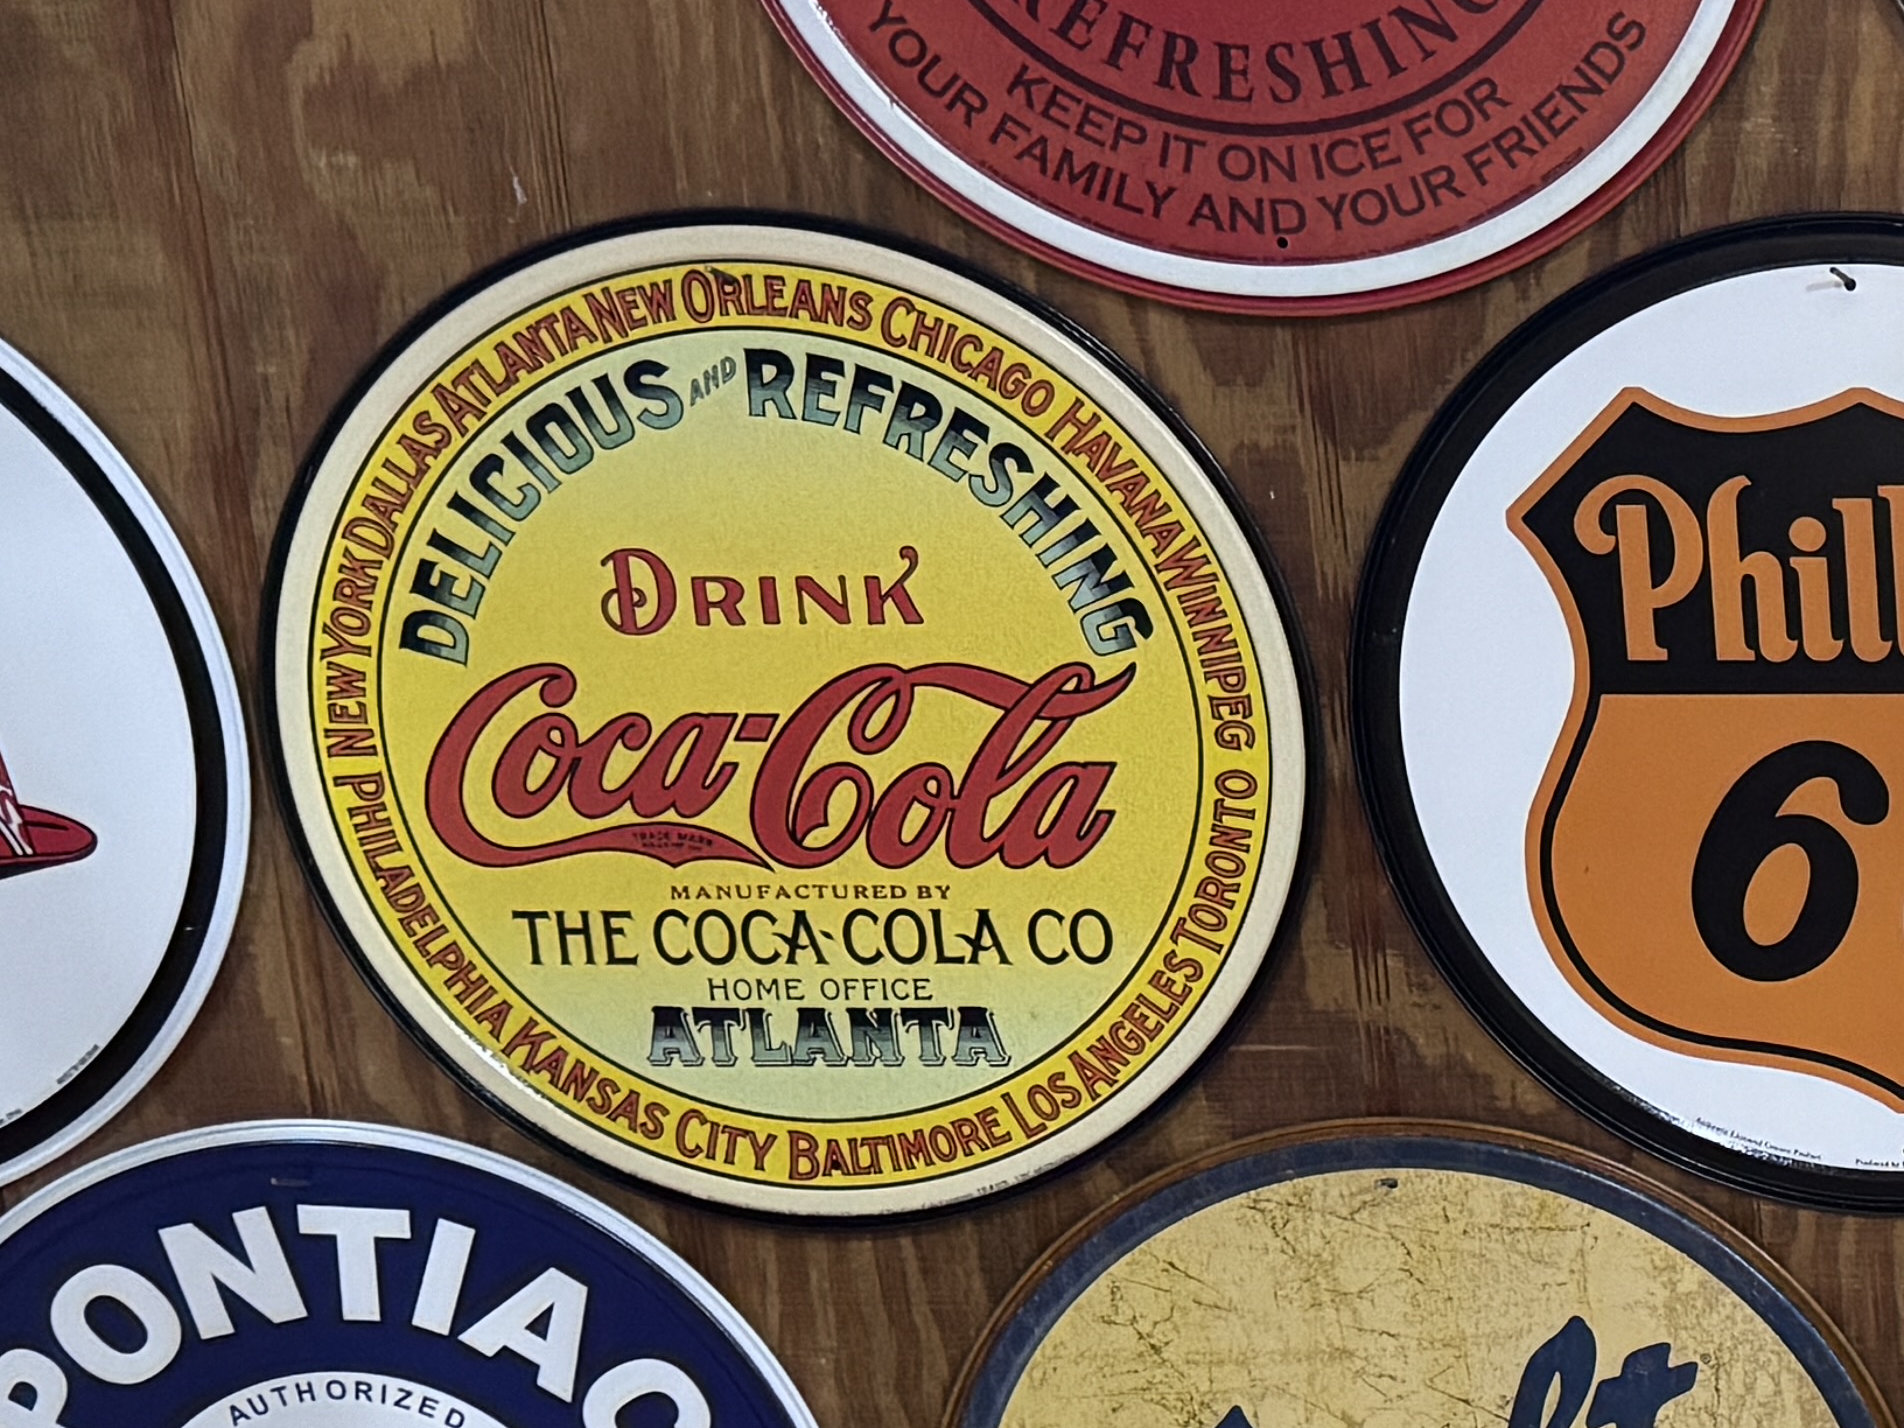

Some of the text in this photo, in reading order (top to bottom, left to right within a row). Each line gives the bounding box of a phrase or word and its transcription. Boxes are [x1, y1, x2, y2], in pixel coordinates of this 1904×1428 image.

[989, 118, 1176, 221] FAMILY
[1188, 194, 1308, 238] AND
[1314, 165, 1460, 241] YOUR
[1464, 9, 1649, 187] FRIENDS
[1005, 65, 1513, 185] KEEP IT ON ICE FOR
[325, 268, 1256, 758] NEW YORK DALLAS ATLANTA NEW ORLEANS CHICAGO HAVANA WINNIPEG
[399, 347, 1154, 667] DELICIOUS AND REFRESHING
[599, 546, 925, 636] DRINK
[424, 662, 1136, 873] Coca-Cola
[512, 910, 639, 967] THE
[1027, 908, 1114, 965] CO
[670, 883, 950, 902] MANUFACTURED BY
[335, 767, 1258, 1182] PHILADELPHIA KANSAS CITY BALTIMORE LOS ANGELES TORONTO
[707, 977, 934, 1002] HOME OFFICE
[646, 1005, 1013, 1070] ATLANTA
